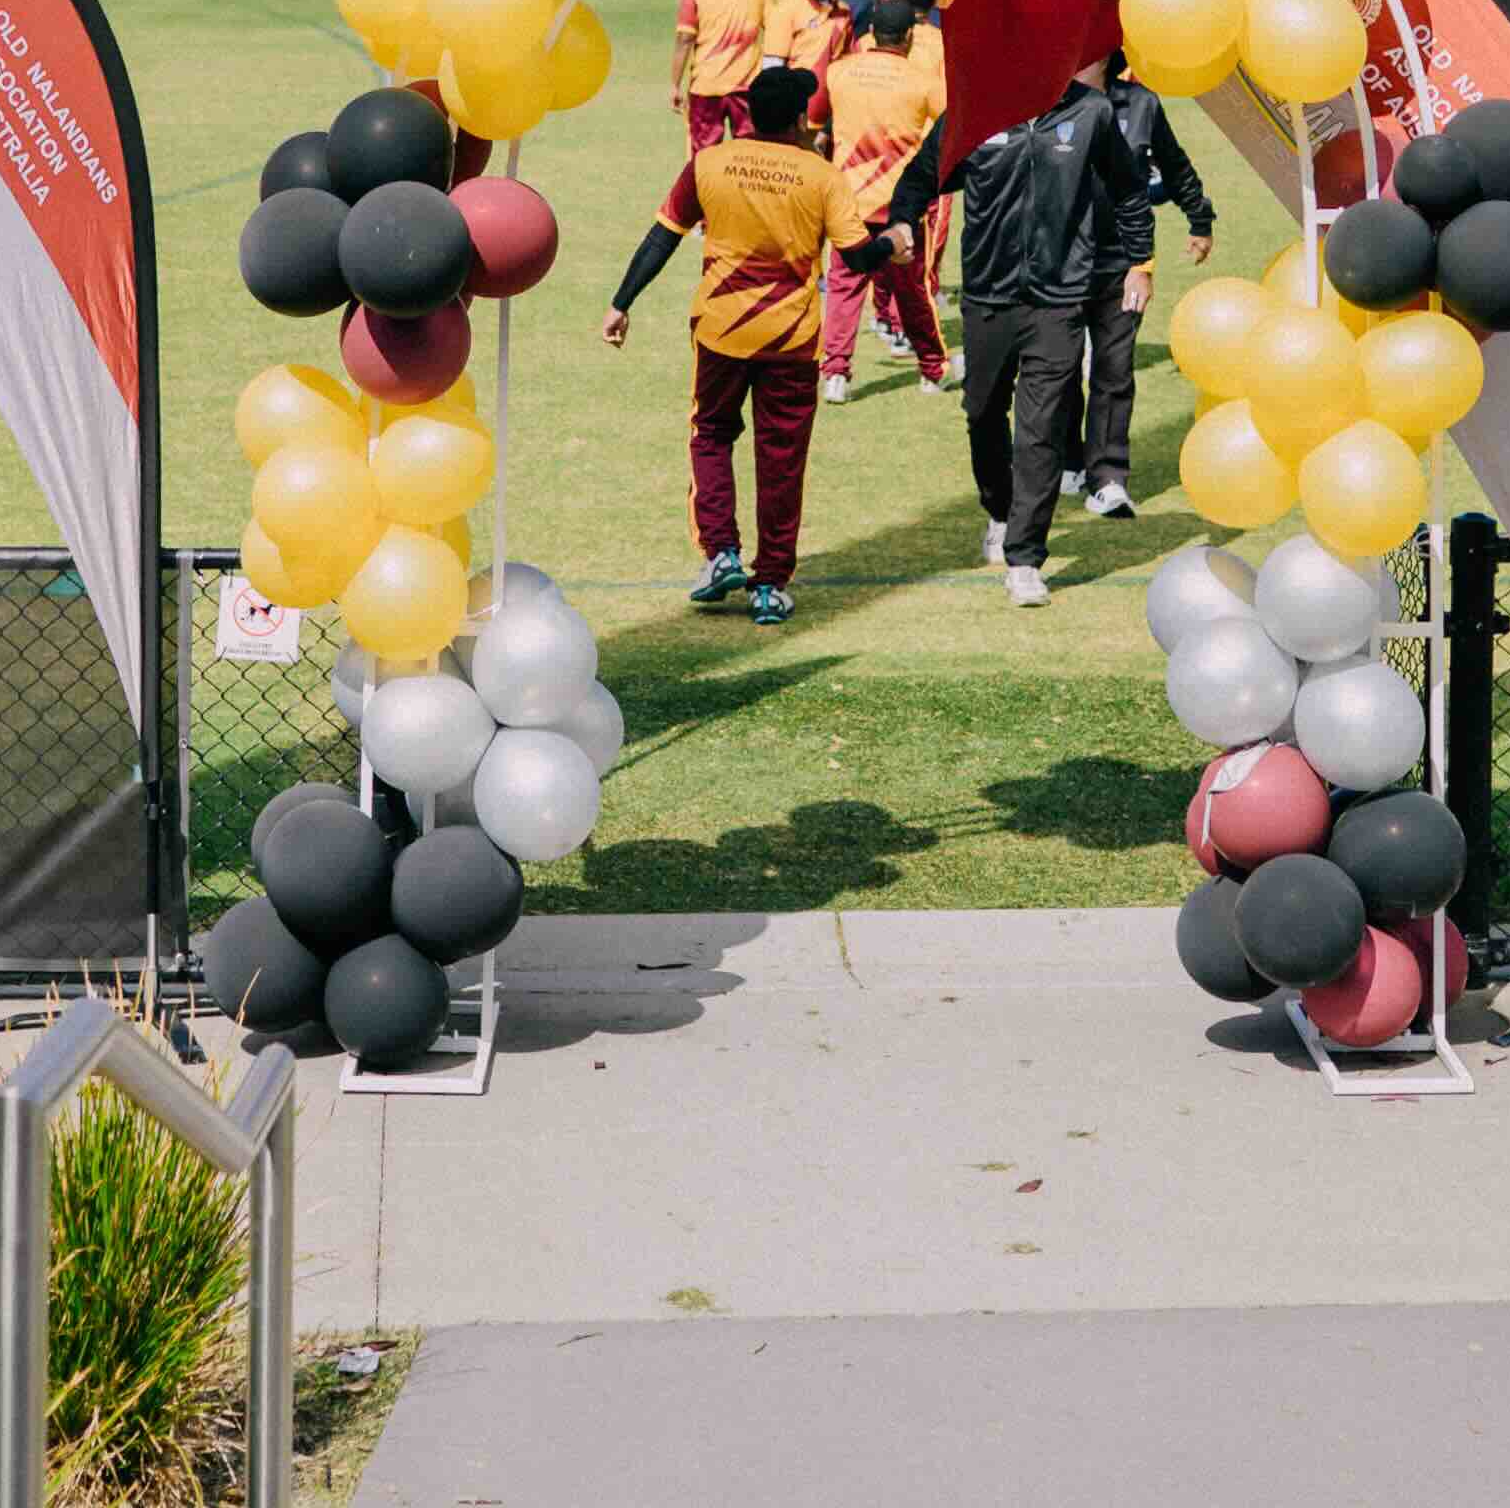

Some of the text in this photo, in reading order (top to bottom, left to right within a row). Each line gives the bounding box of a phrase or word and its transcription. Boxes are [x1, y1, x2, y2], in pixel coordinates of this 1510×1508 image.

[1361, 63, 1393, 92] OF
[26, 62, 119, 205] NALANDIANS
[724, 165, 804, 187] MAROONS
